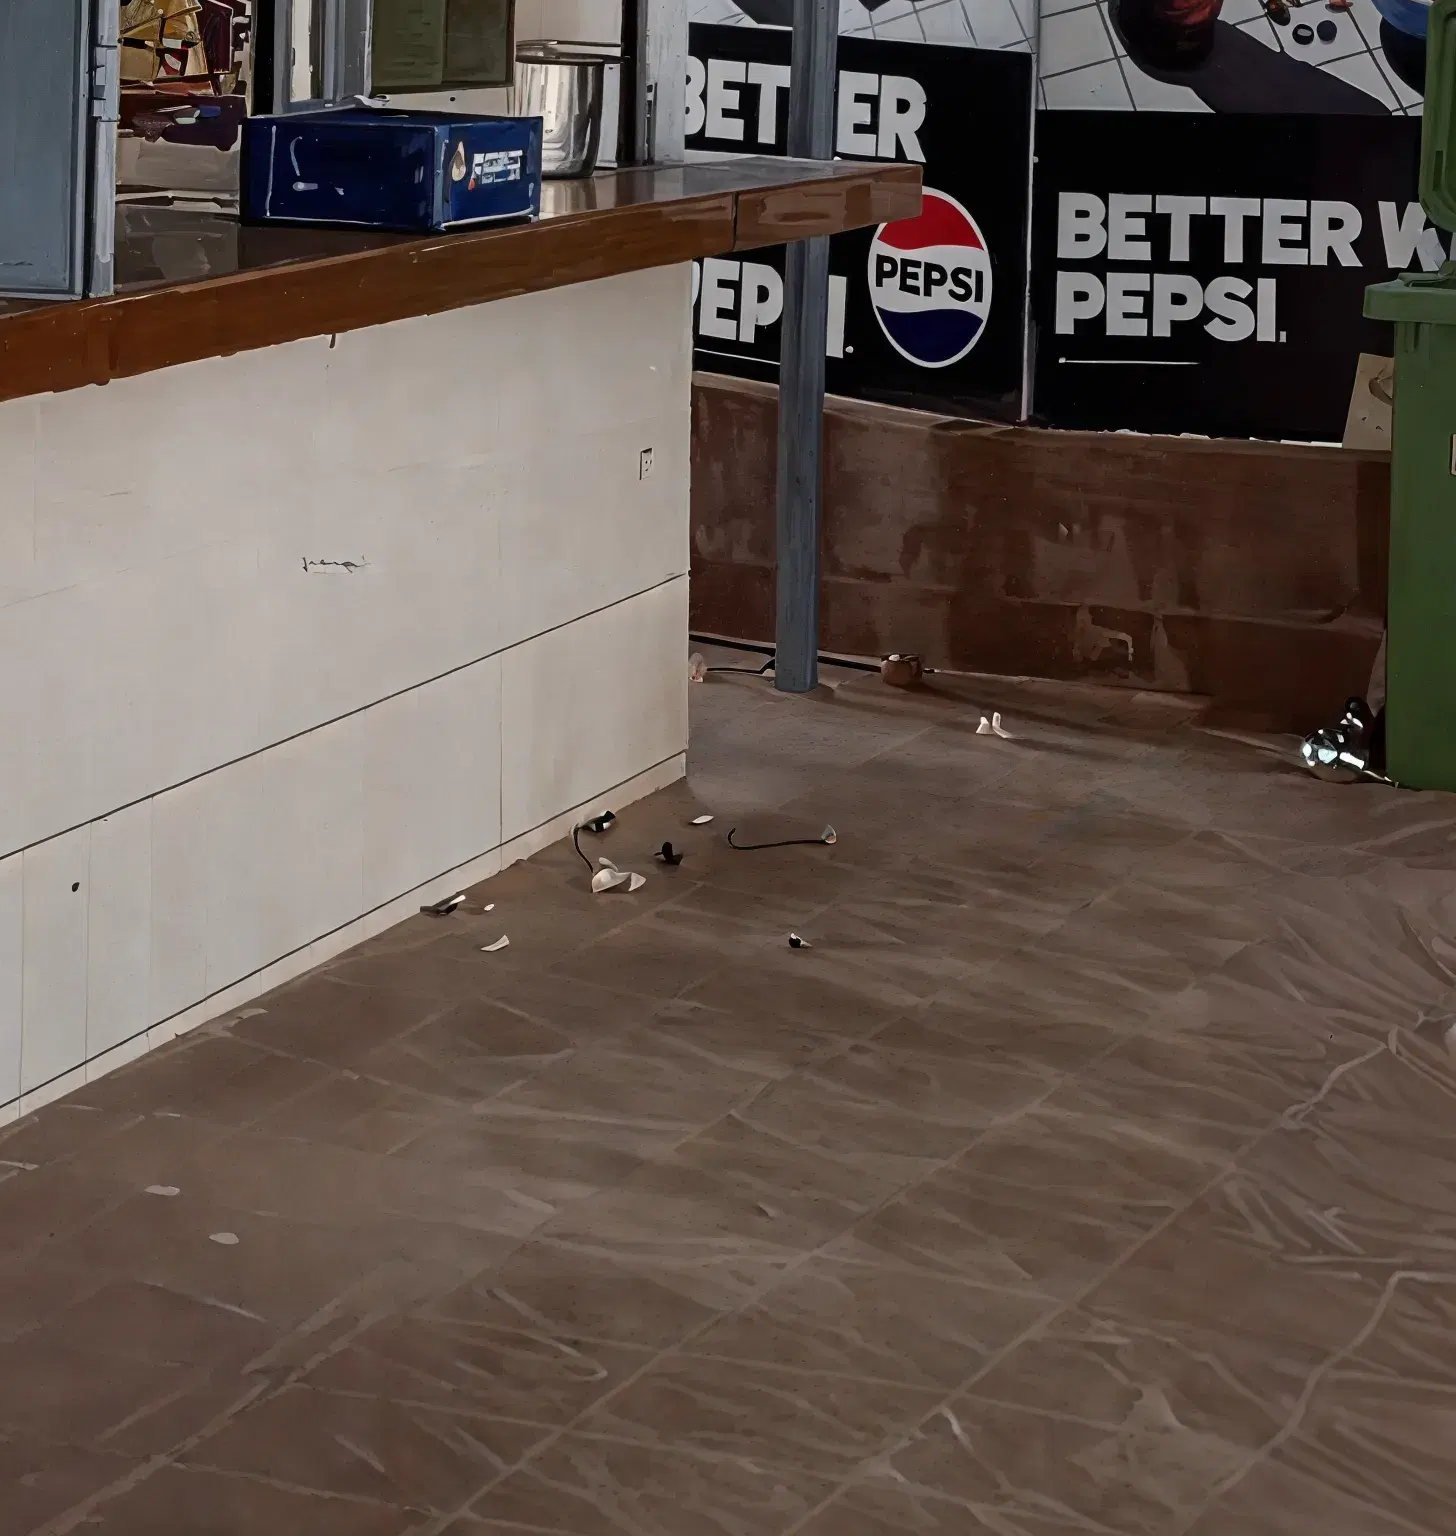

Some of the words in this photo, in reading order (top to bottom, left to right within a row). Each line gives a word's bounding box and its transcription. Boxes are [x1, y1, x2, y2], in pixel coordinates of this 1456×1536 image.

[685, 56, 927, 163] BETER
[1057, 192, 1364, 267] BETTER
[875, 254, 984, 303] PEPSI
[1055, 271, 1287, 343] PEPSI.
